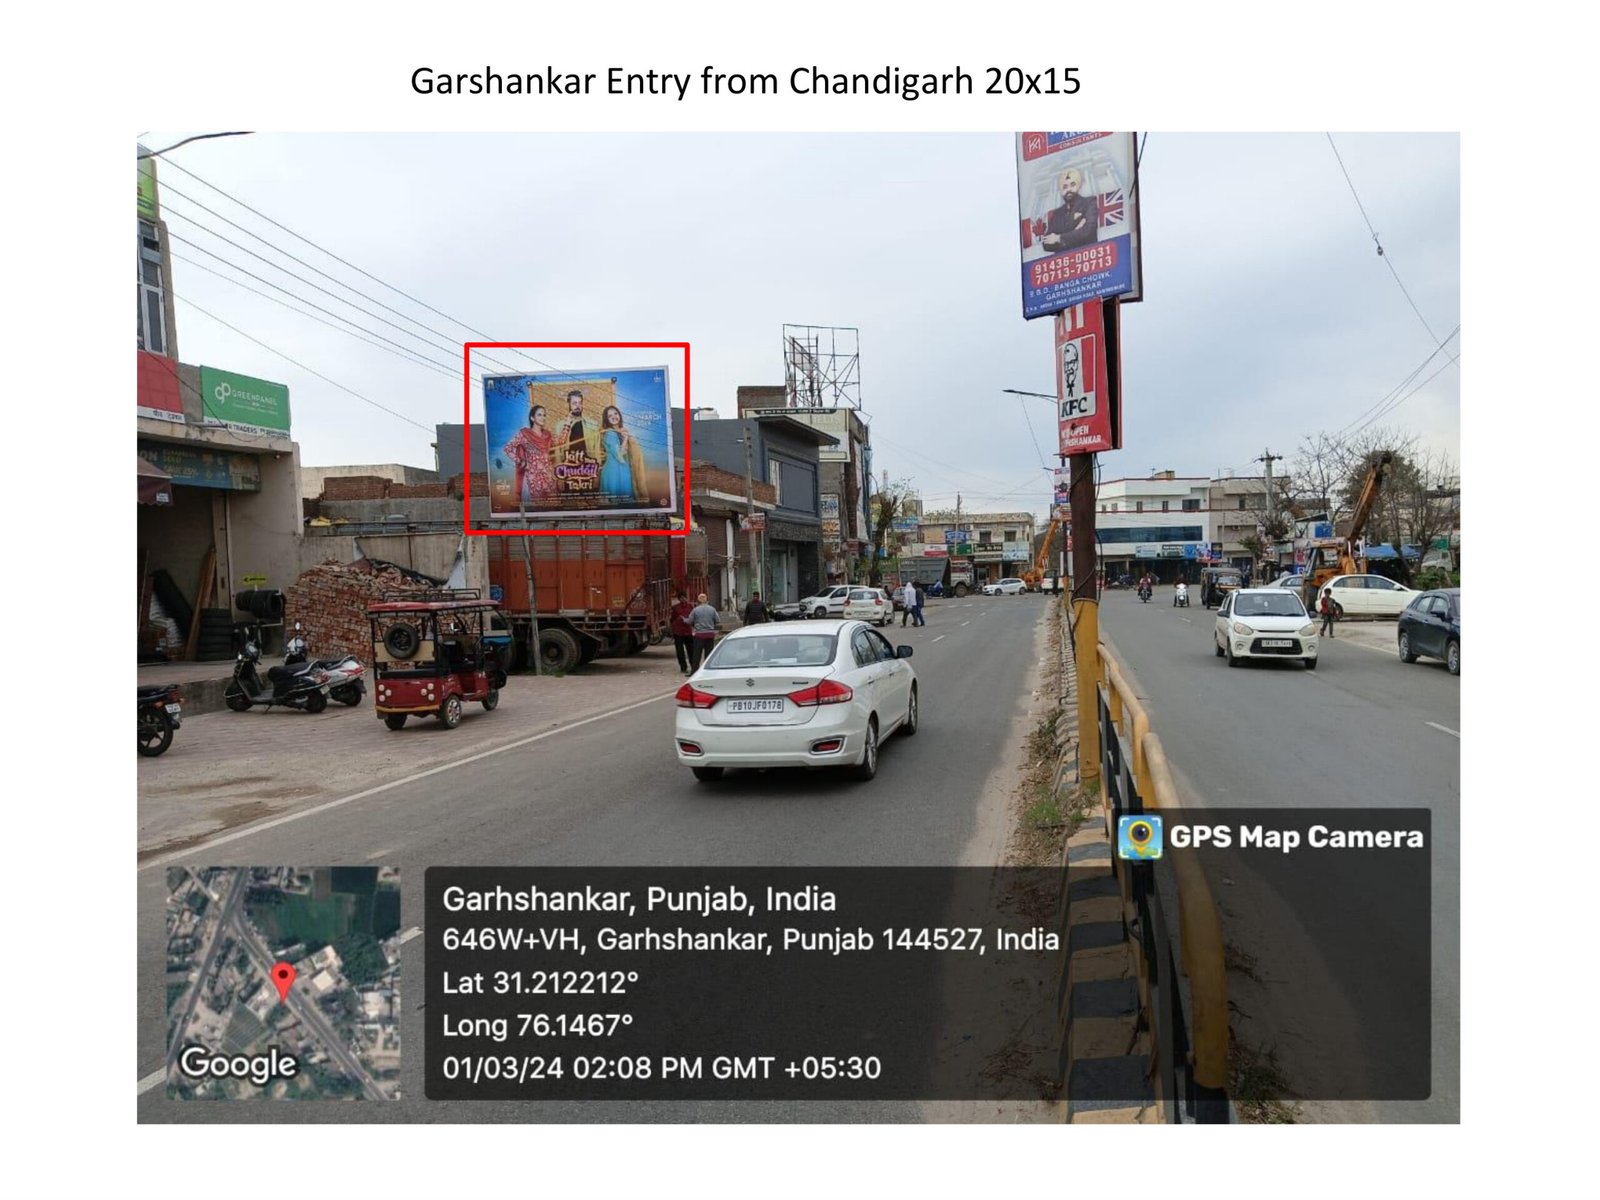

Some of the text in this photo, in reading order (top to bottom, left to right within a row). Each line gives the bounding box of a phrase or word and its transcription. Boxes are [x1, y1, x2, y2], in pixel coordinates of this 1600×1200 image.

[1035, 245, 1111, 275] 91436-00031
[1036, 256, 1112, 286] 70713-70713
[1046, 281, 1102, 301] GARHSHANKAR
[1054, 279, 1080, 291] BANGA
[231, 390, 278, 405] GREENPANEL
[1061, 396, 1088, 417] KFC
[233, 425, 258, 435] TRADERS
[1070, 425, 1089, 437] OPEN
[732, 701, 782, 712] PB10JF0178
